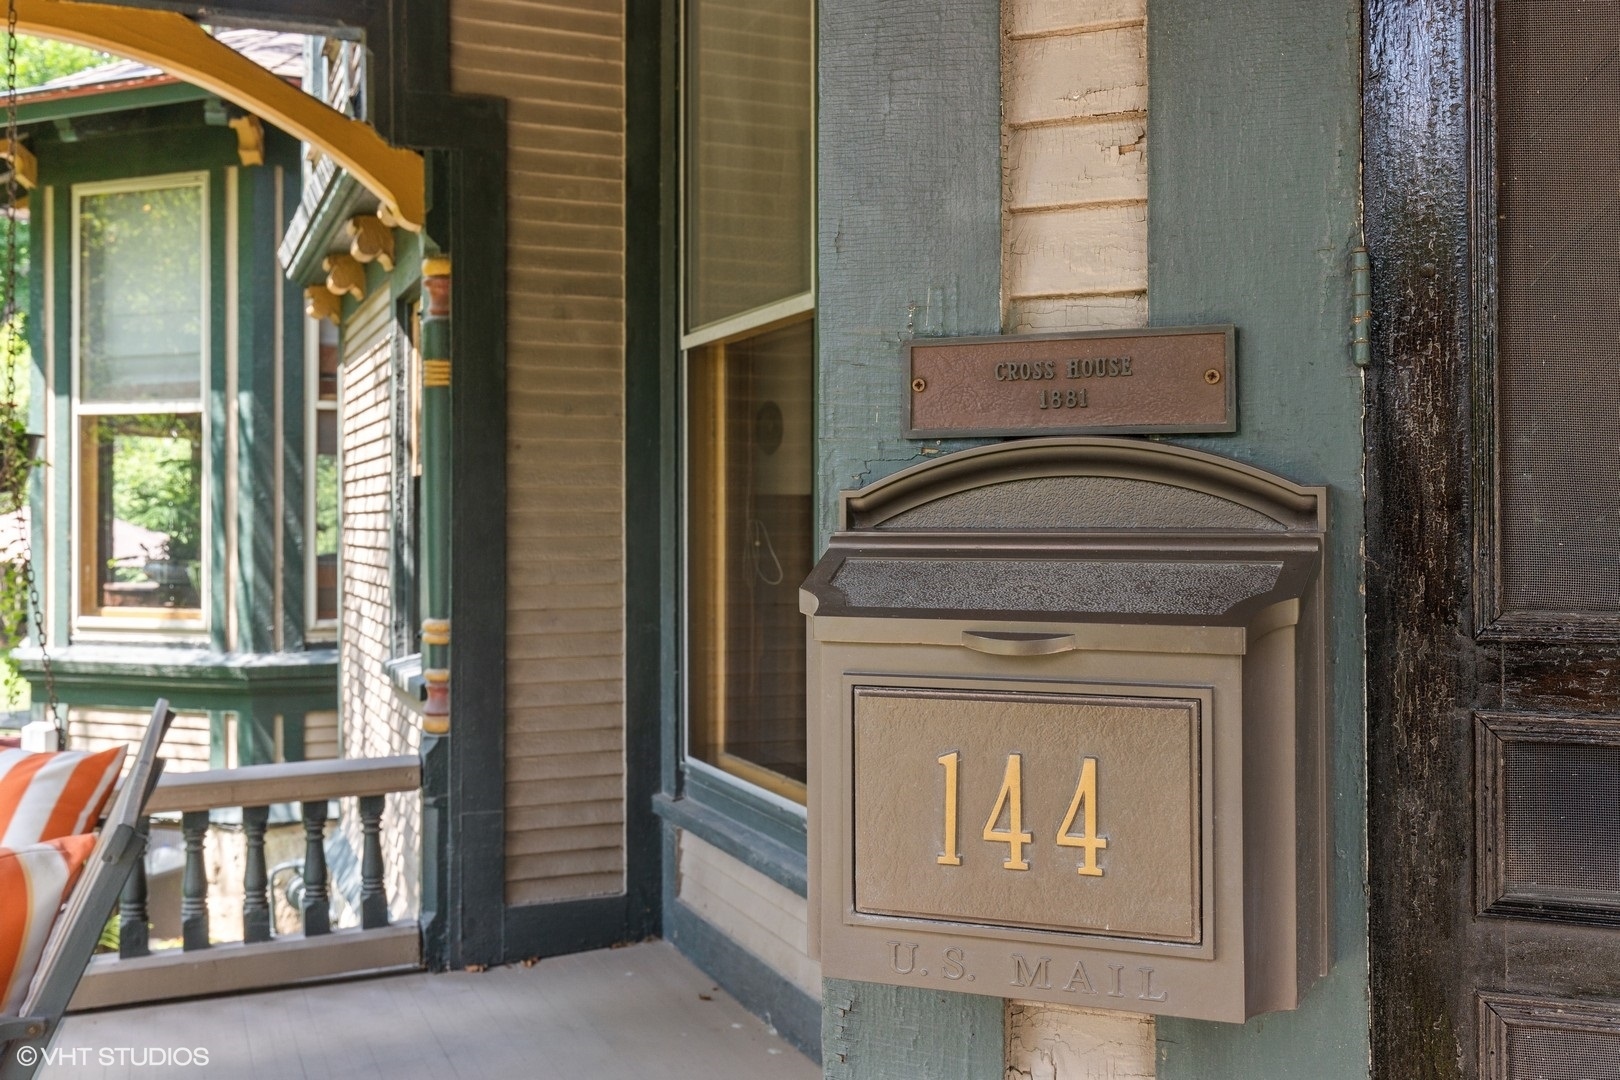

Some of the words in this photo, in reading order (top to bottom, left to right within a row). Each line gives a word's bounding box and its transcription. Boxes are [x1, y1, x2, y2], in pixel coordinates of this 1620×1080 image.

[994, 359, 1056, 381] CROSS
[1066, 355, 1133, 378] HOUSE
[1039, 388, 1088, 409] 1881
[937, 750, 1107, 876] 144
[886, 941, 976, 982] U.S.
[1009, 952, 1168, 1002] MAIL
